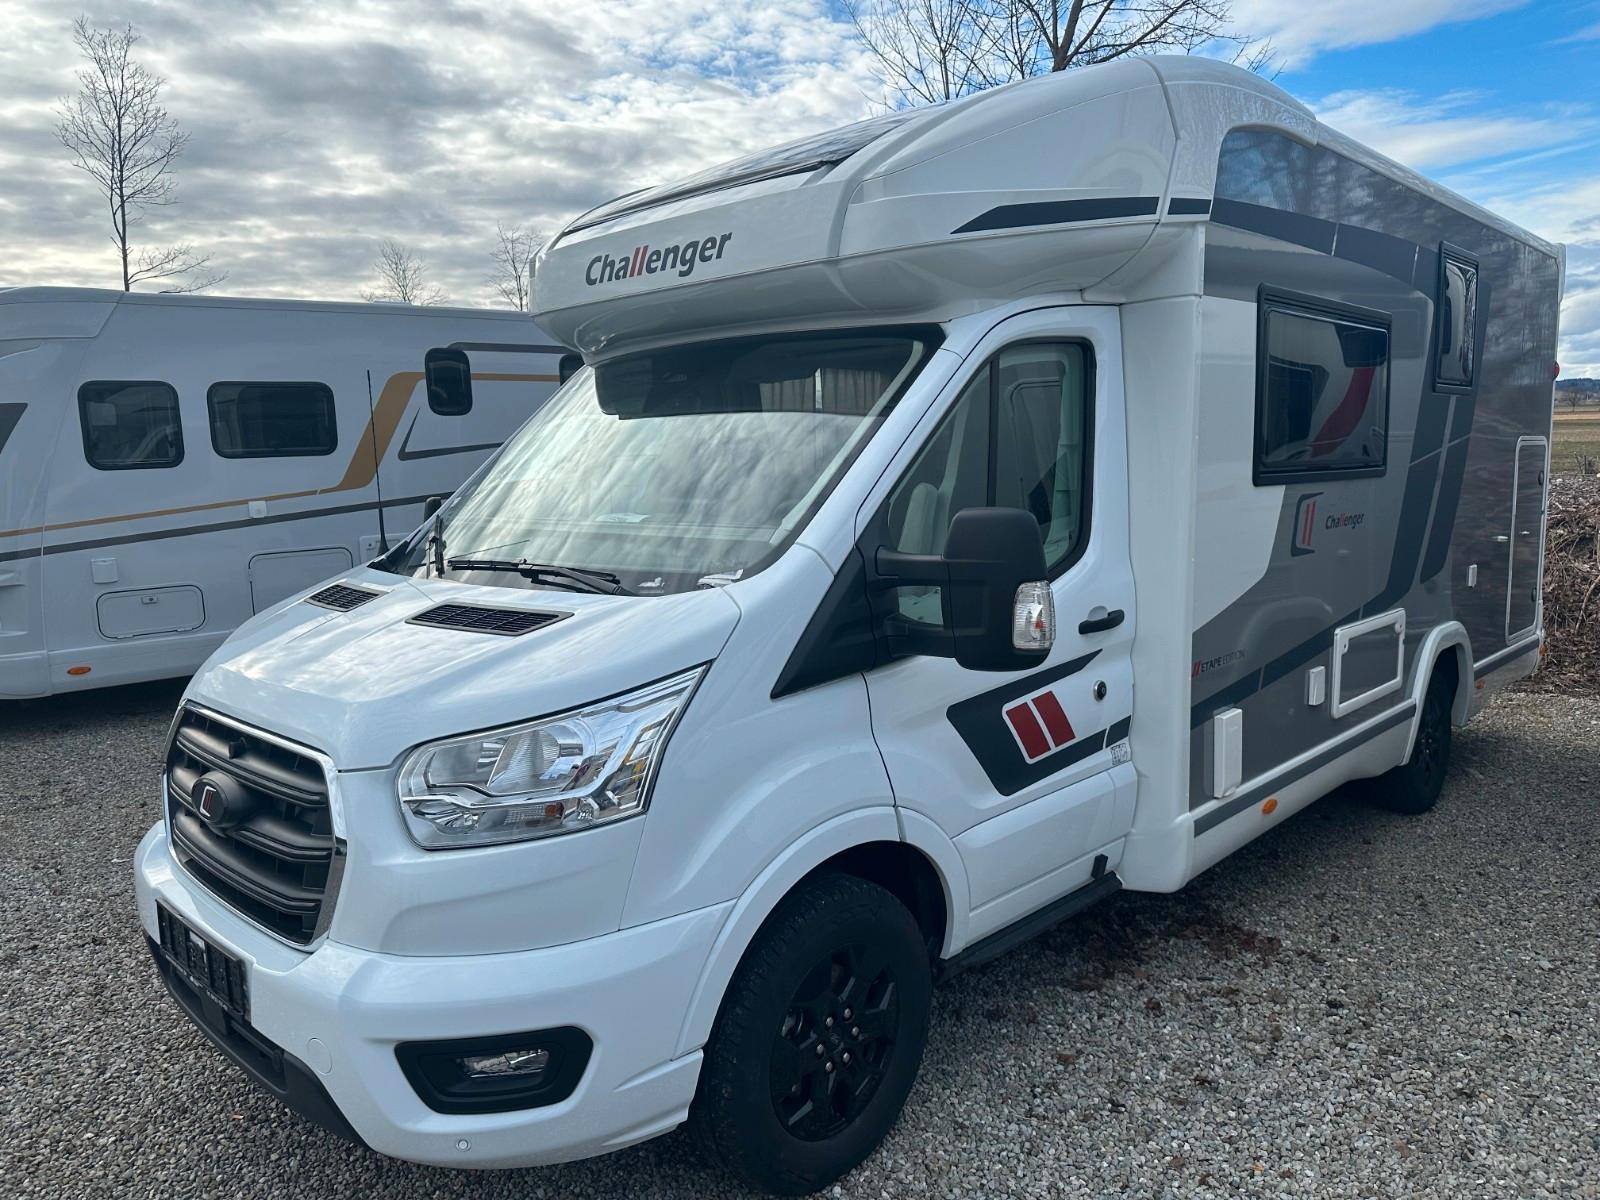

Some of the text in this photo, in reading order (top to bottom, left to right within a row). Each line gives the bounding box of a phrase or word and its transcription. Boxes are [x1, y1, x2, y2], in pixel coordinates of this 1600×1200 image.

[585, 232, 733, 286] Challenger
[1325, 513, 1364, 530] Challenger
[1201, 656, 1222, 673] ETAPE
